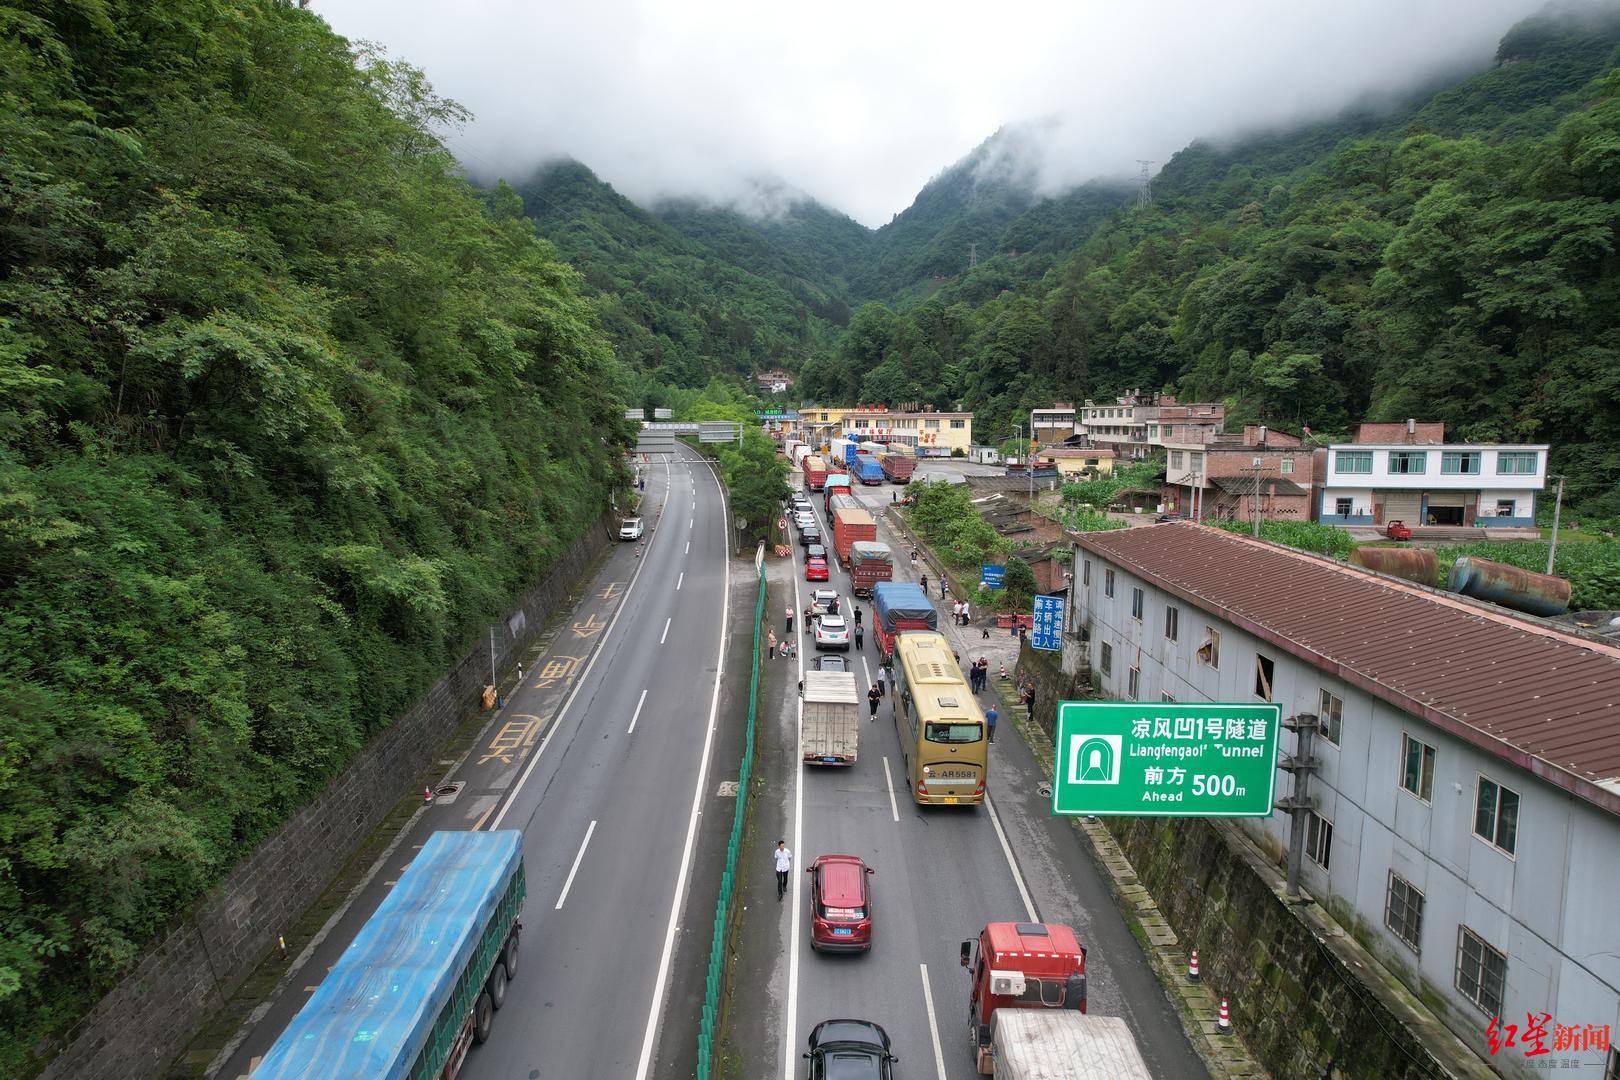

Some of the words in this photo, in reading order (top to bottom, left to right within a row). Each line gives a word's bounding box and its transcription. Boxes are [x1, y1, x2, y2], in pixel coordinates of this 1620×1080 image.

[1033, 598, 1043, 646] 前方路口
[1043, 600, 1053, 648] 车辆出入
[1131, 717, 1268, 740] 凉风凹1号隧道
[1144, 766, 1187, 786] 前方
[1142, 790, 1183, 802] Ahead
